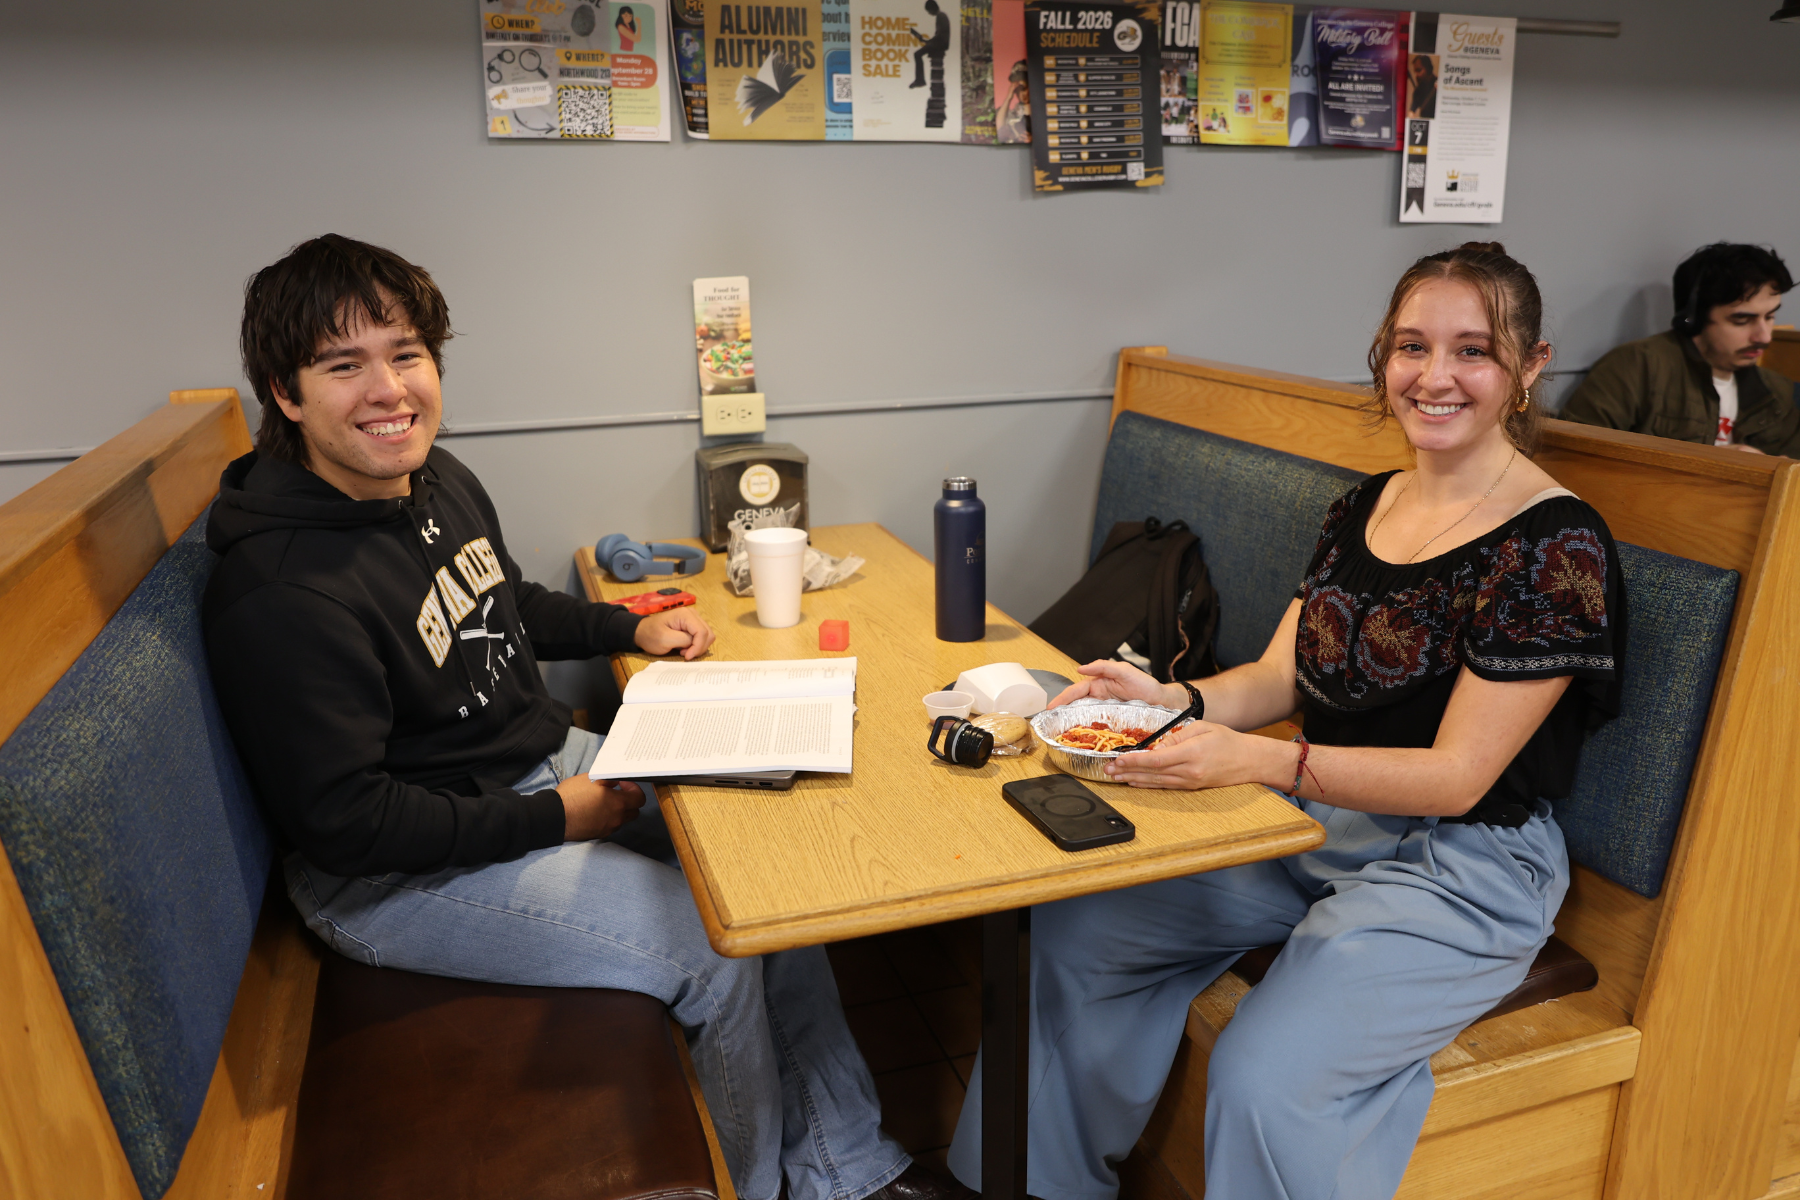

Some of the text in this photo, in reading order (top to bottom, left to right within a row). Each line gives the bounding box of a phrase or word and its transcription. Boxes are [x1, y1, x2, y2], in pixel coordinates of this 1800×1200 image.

[507, 19, 535, 29] WHEN?
[720, 4, 807, 36] ALUMNI
[861, 16, 919, 31] HOME-
[1039, 11, 1113, 30] FALL 2026
[1040, 32, 1101, 48] SCHEDULE
[1317, 25, 1362, 55] Military
[1364, 28, 1394, 47] Ball
[1447, 21, 1504, 53] Guests
[714, 38, 816, 69] AUTHORS
[862, 48, 910, 62] BOOK
[1463, 46, 1500, 54] @GENEVA
[574, 52, 605, 62] WHERE?
[616, 57, 642, 65] Monday
[559, 68, 599, 79] NORTHWOOD
[862, 63, 902, 78] SALE
[1444, 63, 1471, 76] Songs
[1328, 81, 1385, 92] ALL ARE INVITED!
[1443, 76, 1483, 86] of Ascent
[511, 86, 531, 94] Share
[1411, 121, 1426, 131] OCT
[1414, 131, 1423, 144] 7
[704, 294, 740, 302] THOUGHT
[734, 507, 785, 521] GENEVA
